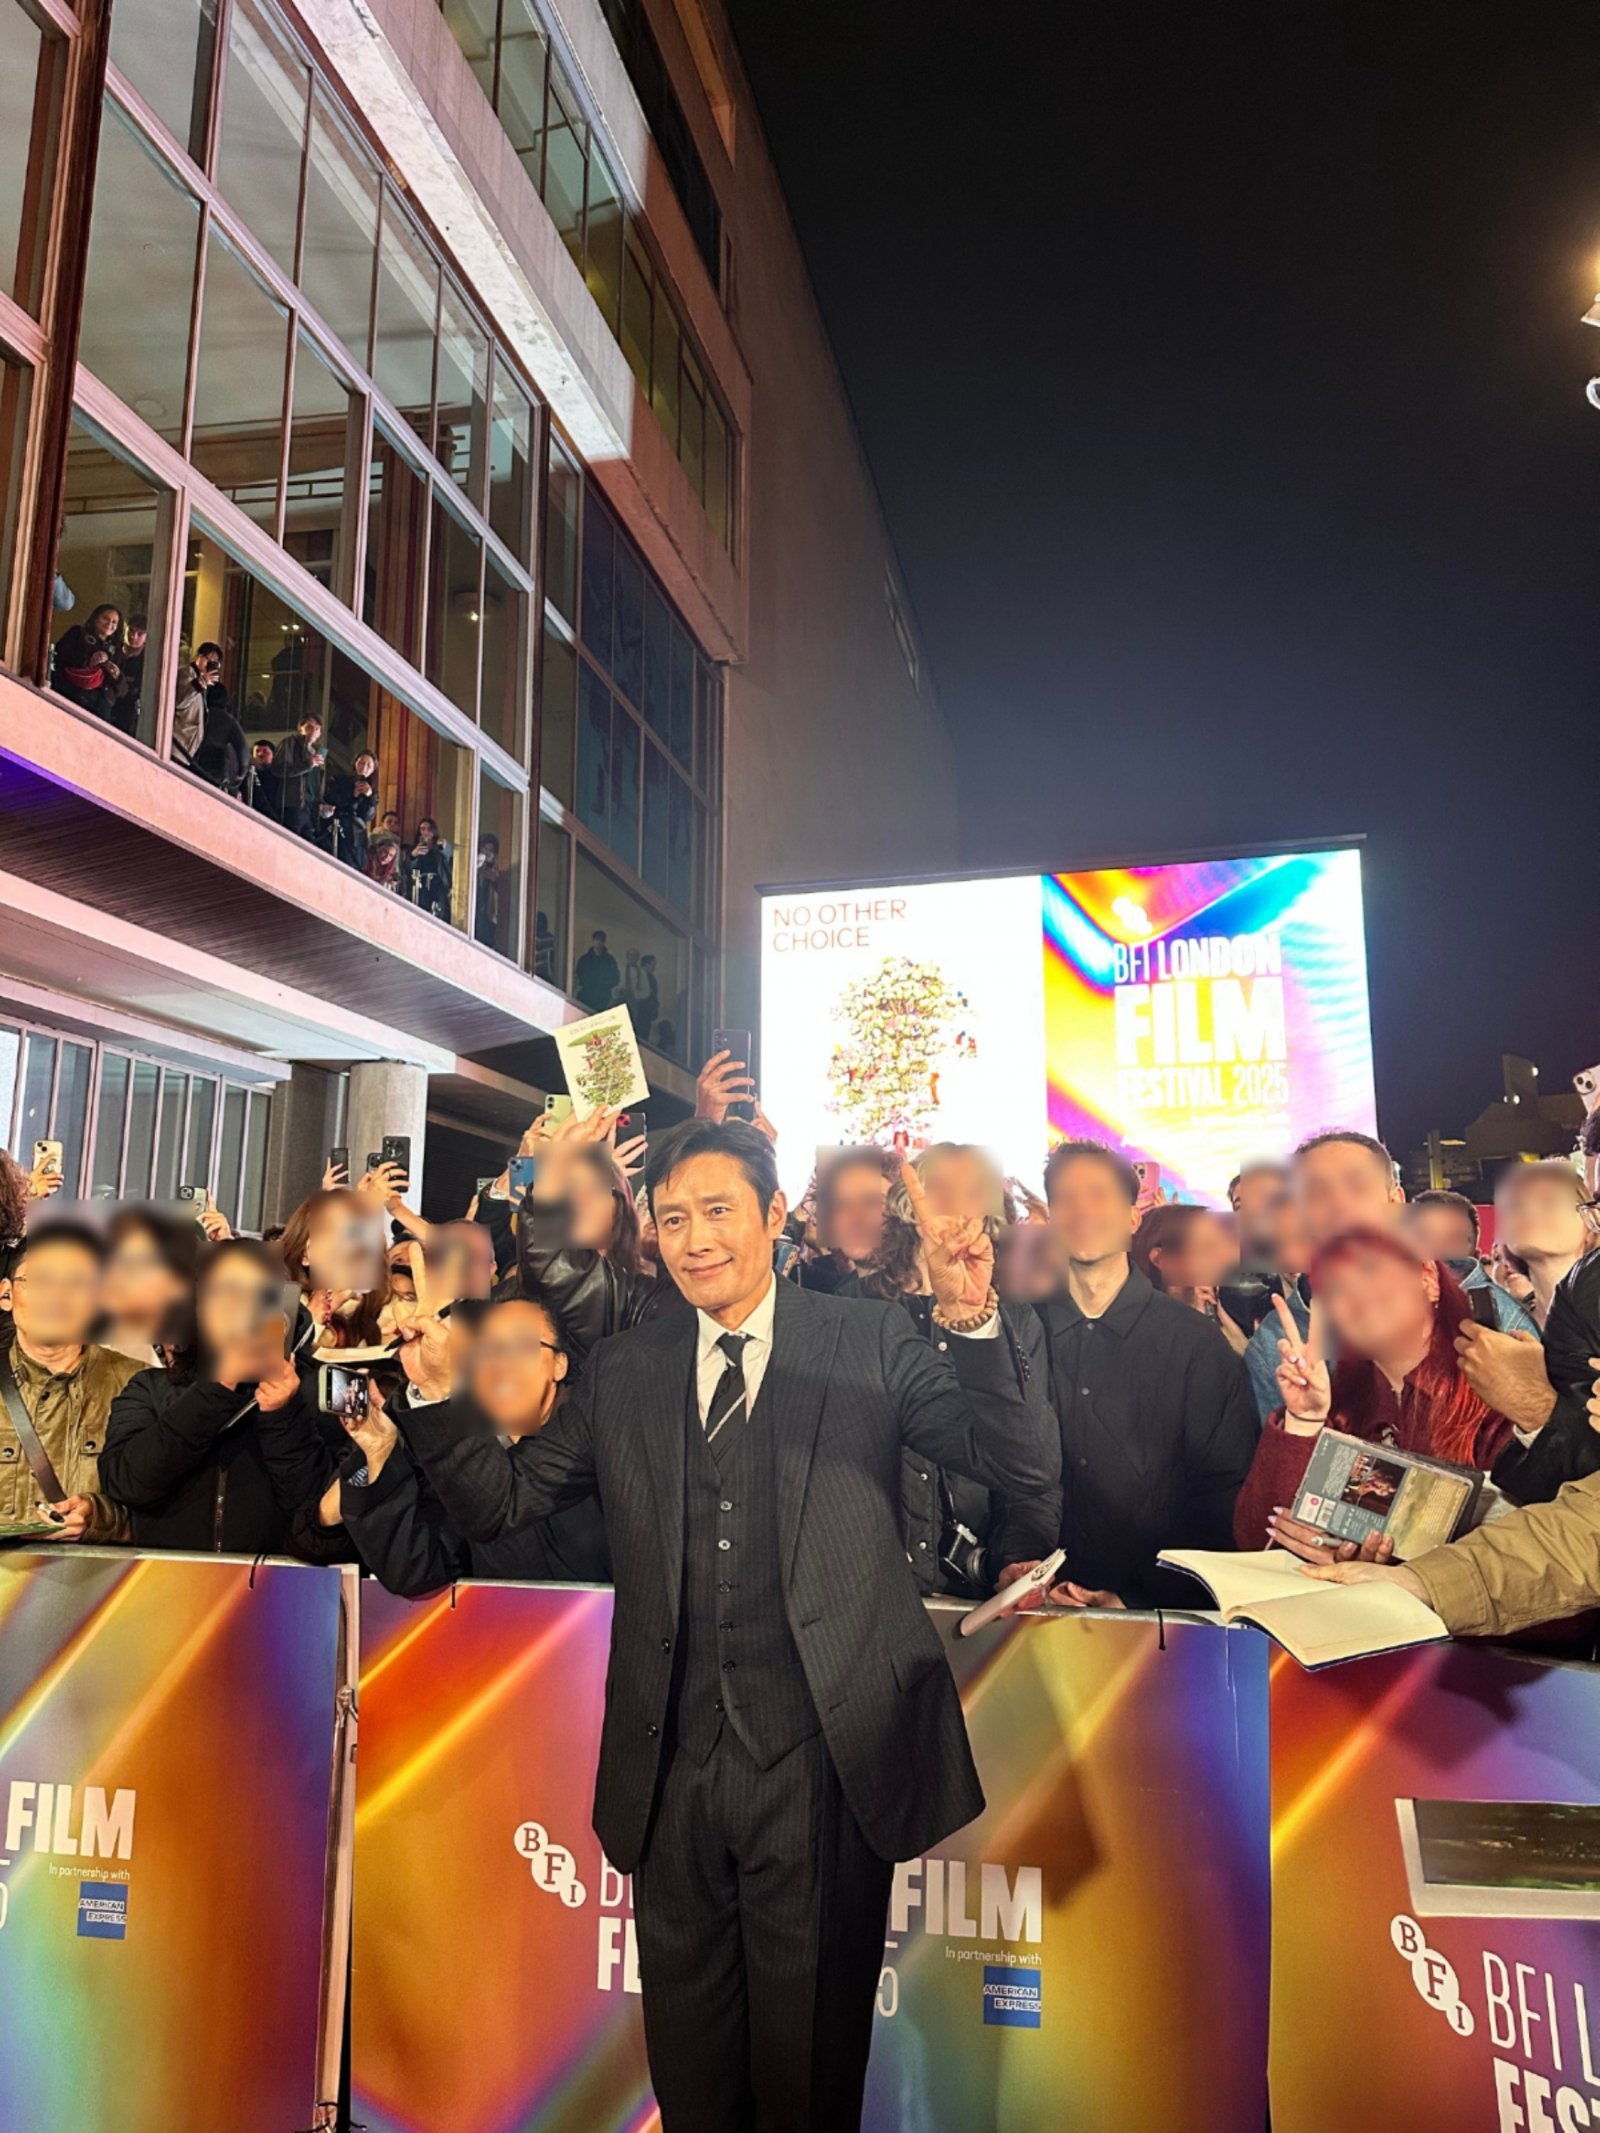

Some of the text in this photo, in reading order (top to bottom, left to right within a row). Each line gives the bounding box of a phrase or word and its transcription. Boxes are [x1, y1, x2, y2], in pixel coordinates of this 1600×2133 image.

[773, 898, 906, 927] NO OTHER
[773, 926, 870, 952] CHOICE
[1114, 932, 1282, 983] BFI LONDON
[1115, 976, 1288, 1067] FILM
[1118, 1062, 1289, 1109] FESTIVAL 2025
[5, 1780, 137, 1860] FILM
[49, 1862, 131, 1881] In partnership with
[80, 1898, 125, 1911] AMERICAN
[891, 1857, 1042, 1944] FILM
[87, 1912, 127, 1924] EXPRESS
[945, 1946, 1042, 1966] In partnership with
[984, 1985, 1037, 1998] AMERICAN
[995, 1999, 1041, 2012] EXPRESS
[1482, 1950, 1562, 2071] BFI
